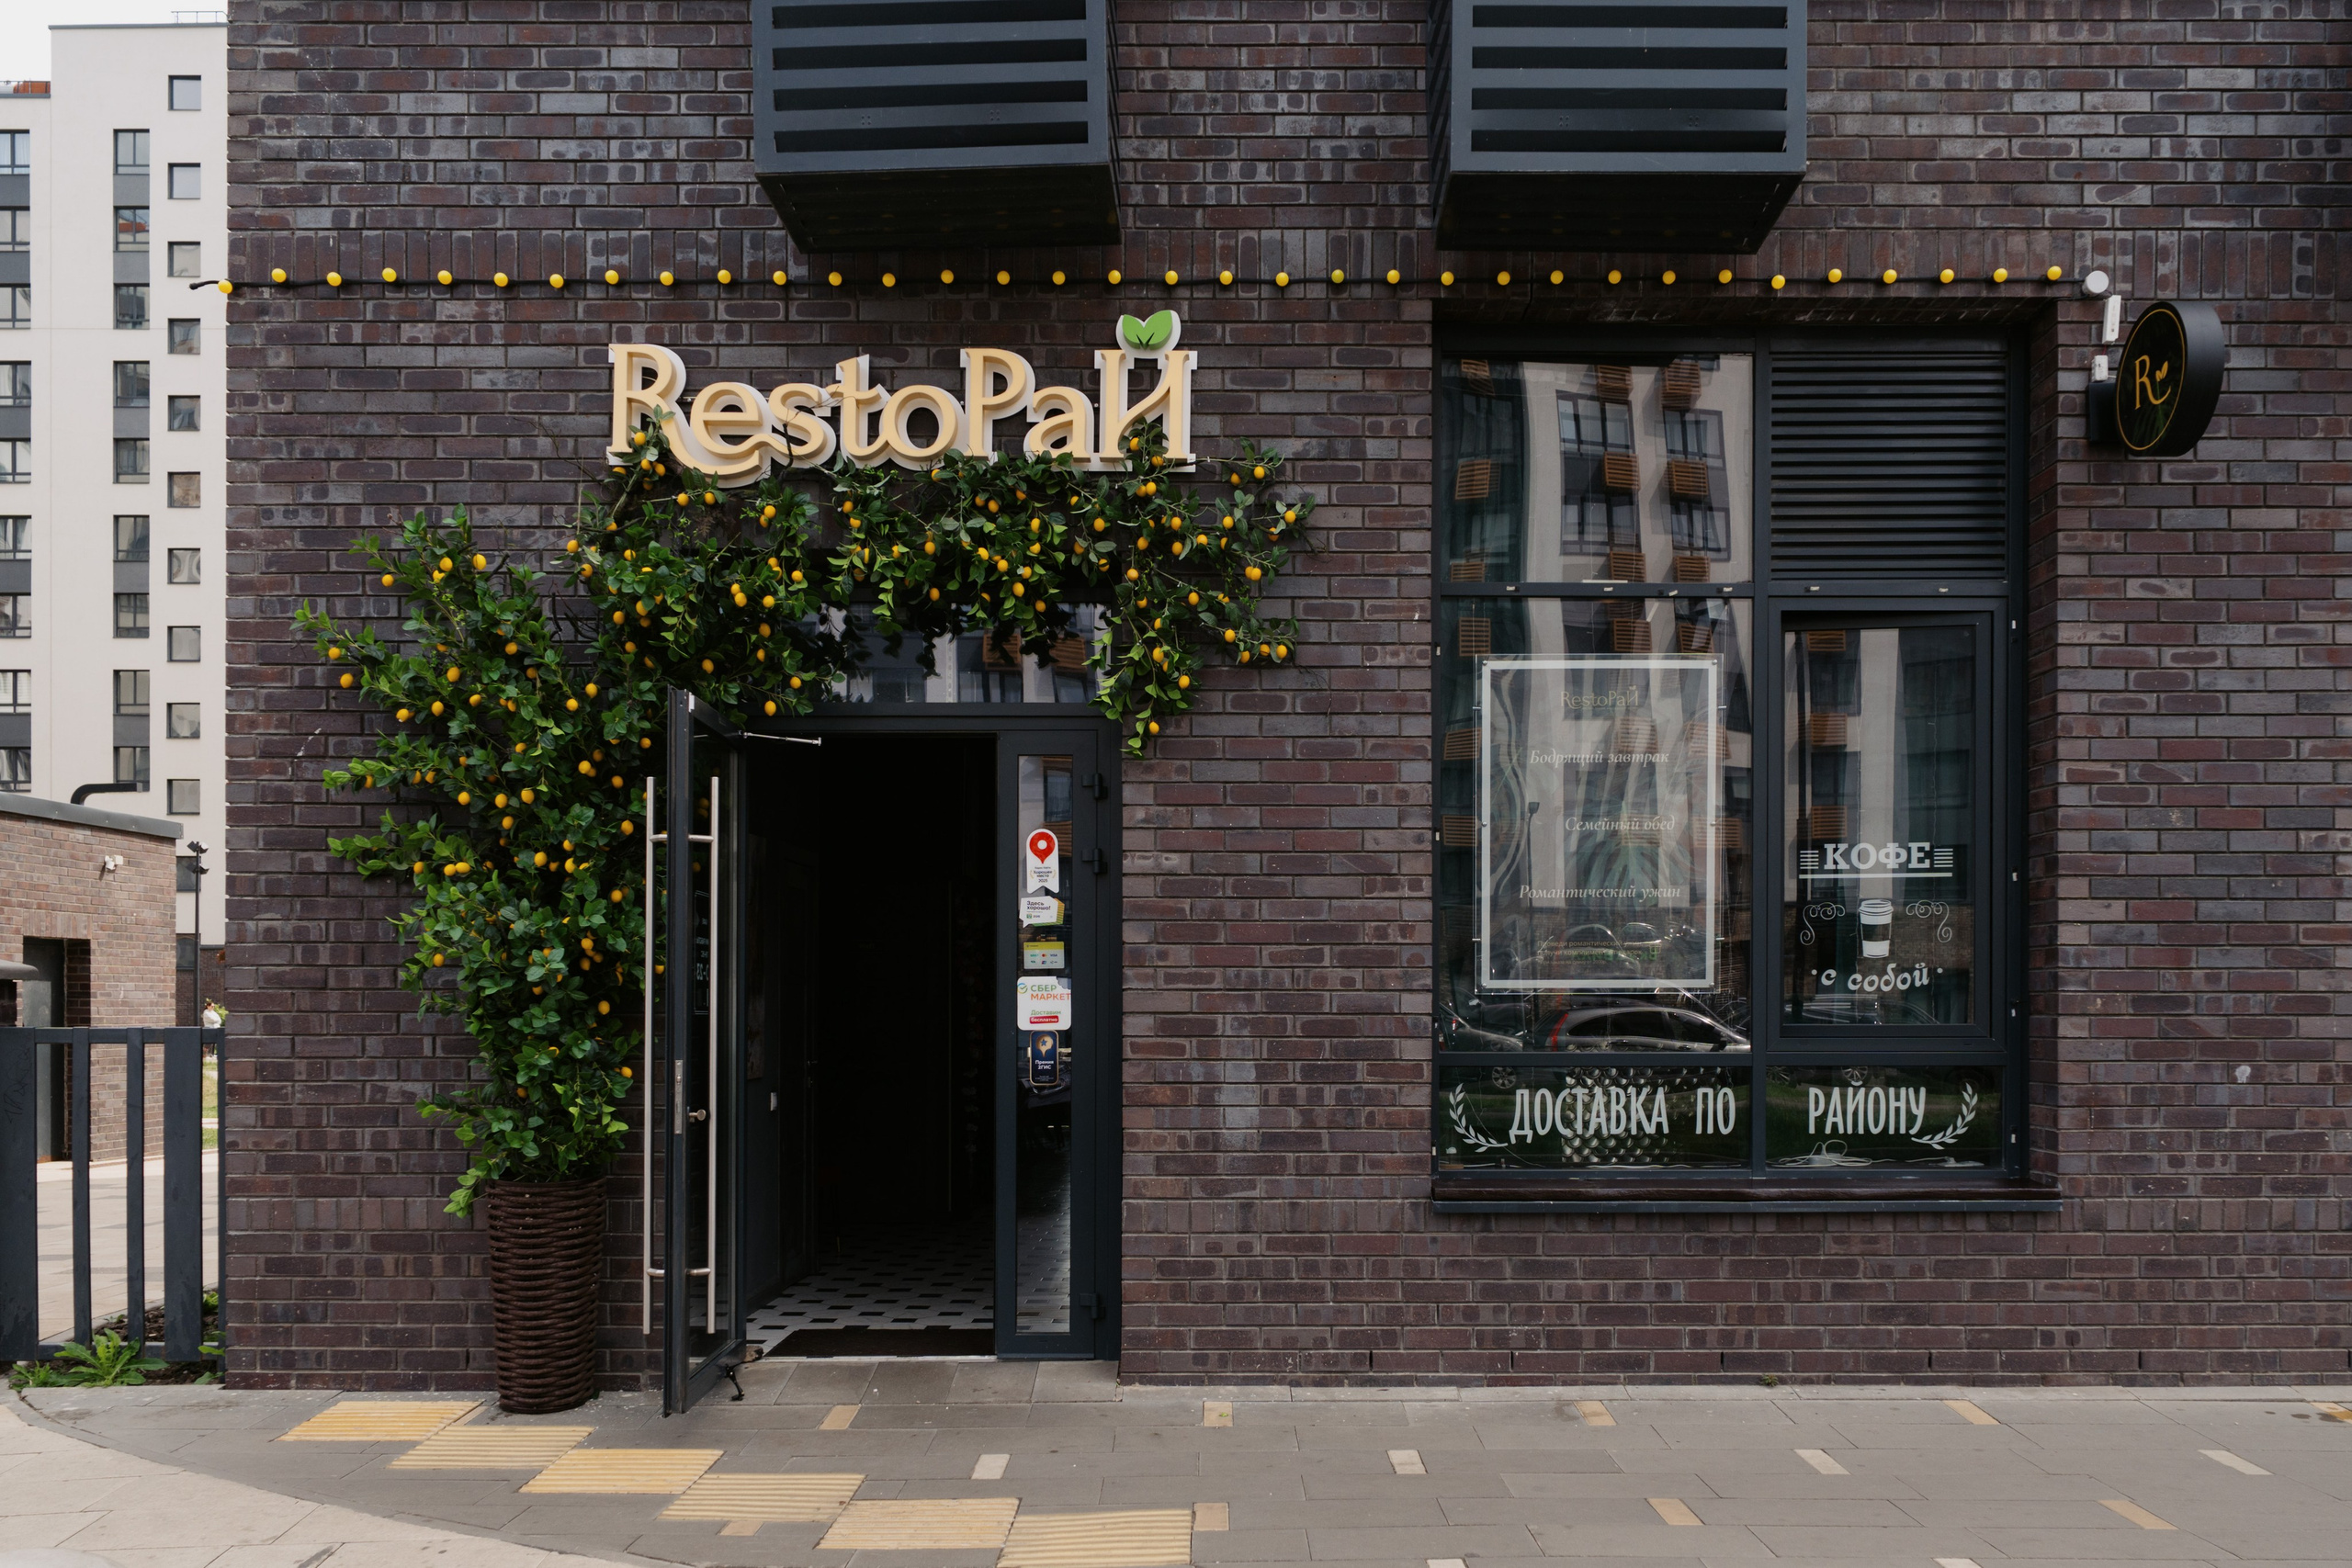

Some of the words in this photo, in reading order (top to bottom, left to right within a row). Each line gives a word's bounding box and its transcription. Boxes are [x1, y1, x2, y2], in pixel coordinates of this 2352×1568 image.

[1530, 749, 1603, 768] Бодрящий
[1608, 751, 1669, 767] завтрак
[1566, 817, 1640, 831] Семейный
[1644, 815, 1676, 831] обед
[1823, 842, 1930, 870] КОФЕ
[1519, 885, 1636, 899] Романтический
[1639, 887, 1680, 903] ужин
[1569, 940, 1623, 948] романтический
[1848, 963, 1930, 992] собой
[1030, 984, 1057, 992] СБЕР
[1509, 1086, 1669, 1145] ДОСТАВКА
[1695, 1087, 1736, 1135] ПО
[1807, 1080, 1927, 1135] РАЙОНУ
